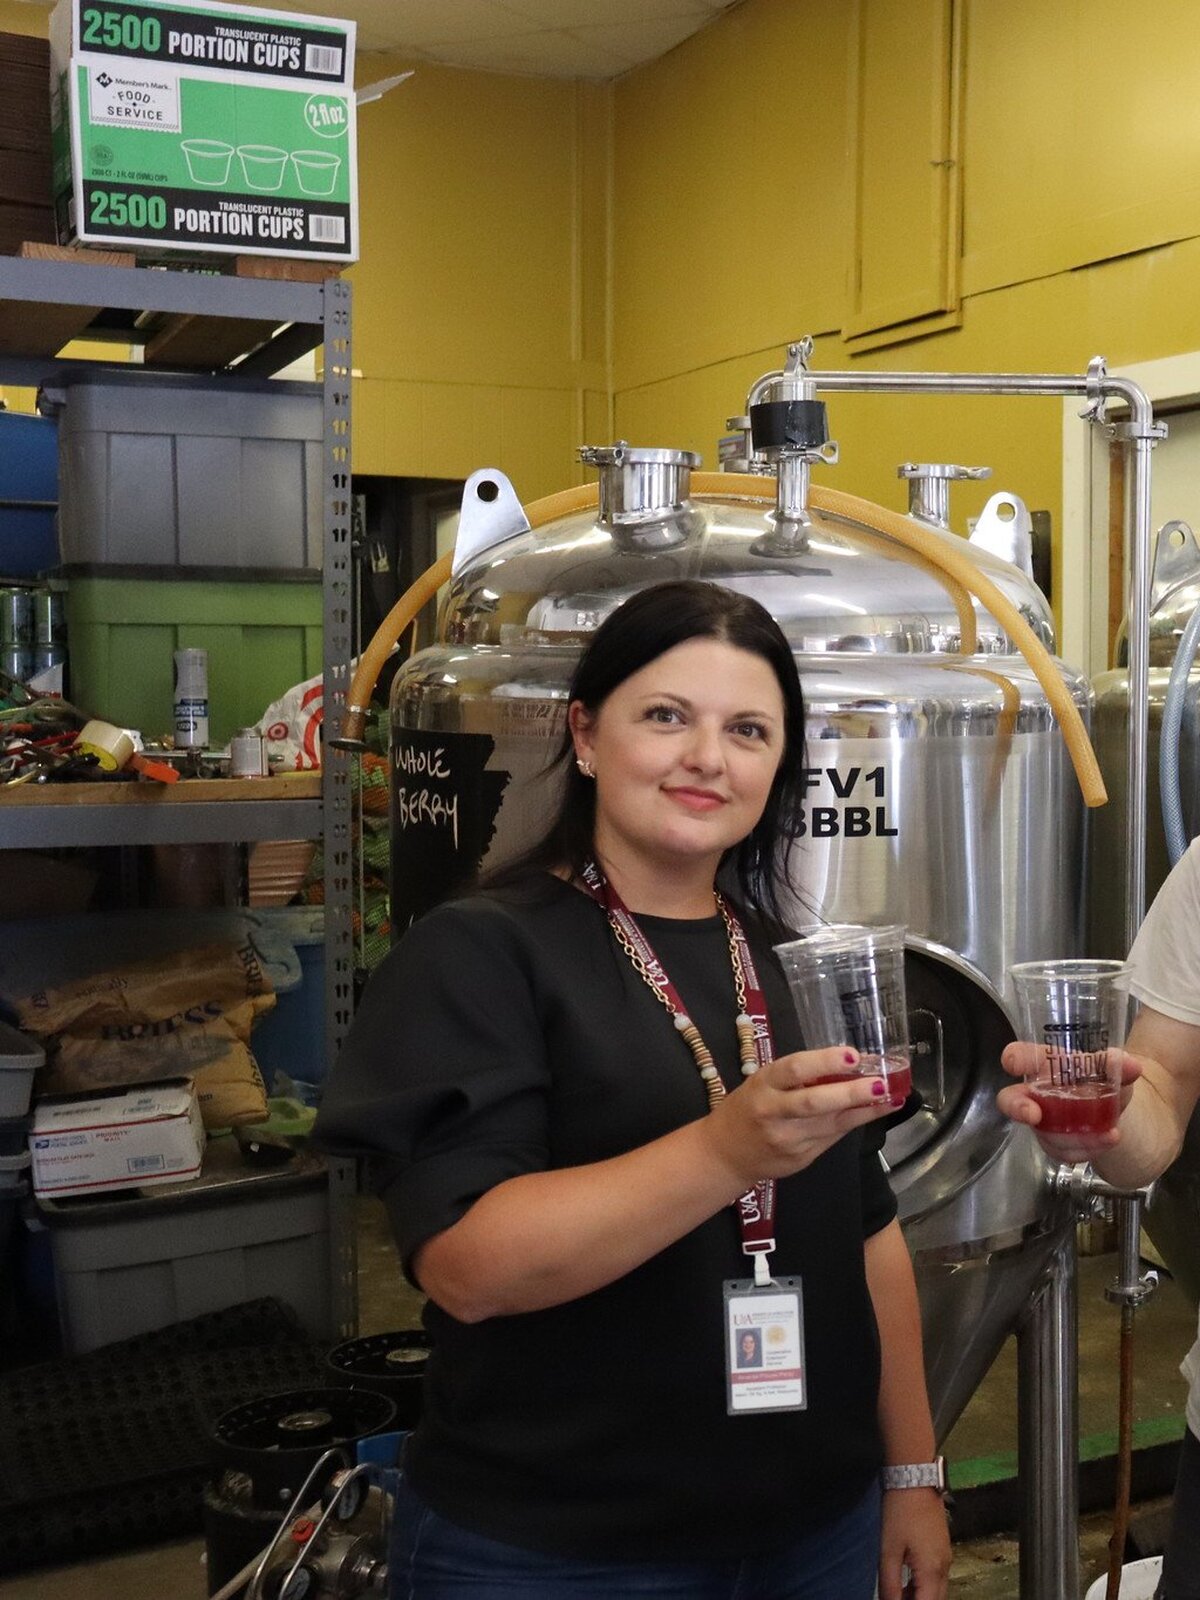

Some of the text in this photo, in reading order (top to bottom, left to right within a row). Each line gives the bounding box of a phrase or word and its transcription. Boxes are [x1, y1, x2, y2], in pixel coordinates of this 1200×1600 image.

[83, 9, 161, 52] 2500
[215, 26, 301, 47] TRANSLUCENT PLASTIC
[168, 30, 300, 70] PORTION CUPS
[115, 78, 149, 89] Member's
[117, 90, 151, 104] FOOD
[107, 105, 163, 121] SERVICE
[90, 191, 166, 229] 2500
[173, 208, 304, 241] PORTION CUPS
[218, 202, 304, 218] TRANSLUCENT PLASTIC
[396, 746, 450, 778] WHOLE
[801, 767, 885, 799] FV1
[399, 787, 458, 850] BERRY
